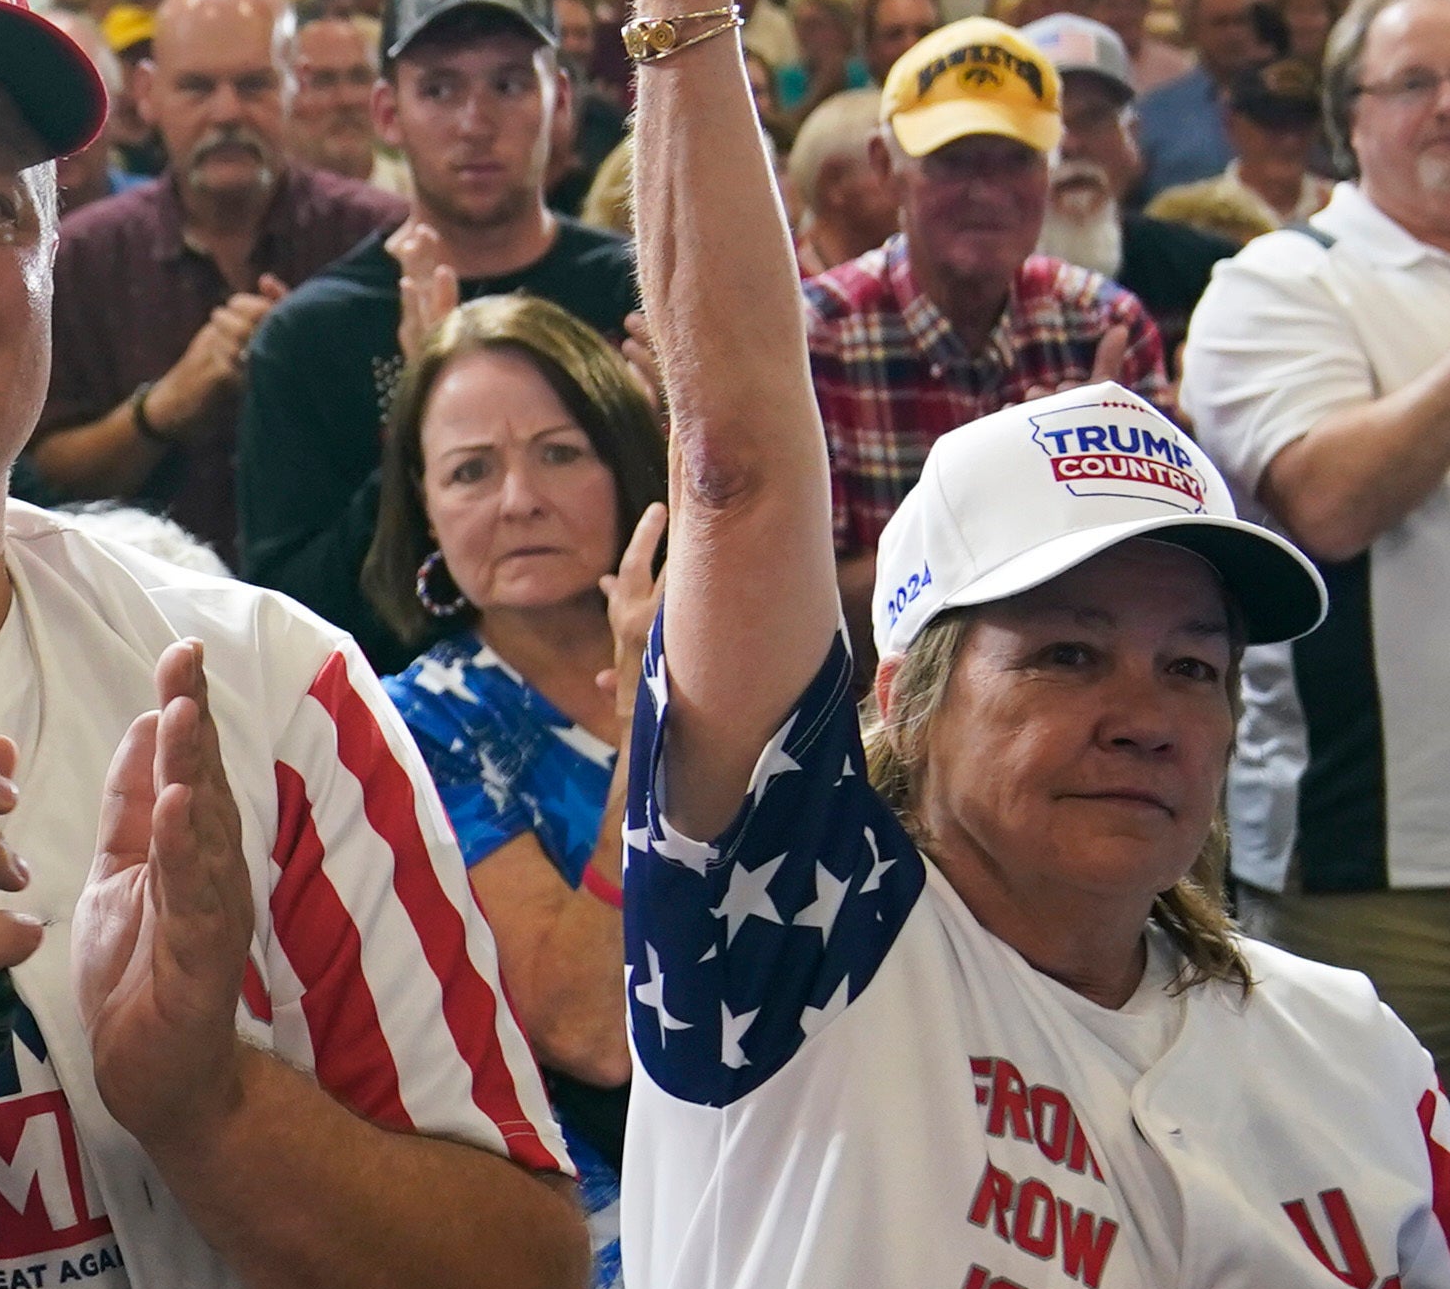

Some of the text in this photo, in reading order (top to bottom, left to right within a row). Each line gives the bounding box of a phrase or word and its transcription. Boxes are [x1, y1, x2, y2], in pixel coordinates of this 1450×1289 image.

[1043, 424, 1193, 469] TRUMP
[1058, 456, 1199, 497] COUNTRY
[888, 559, 932, 630] 2024
